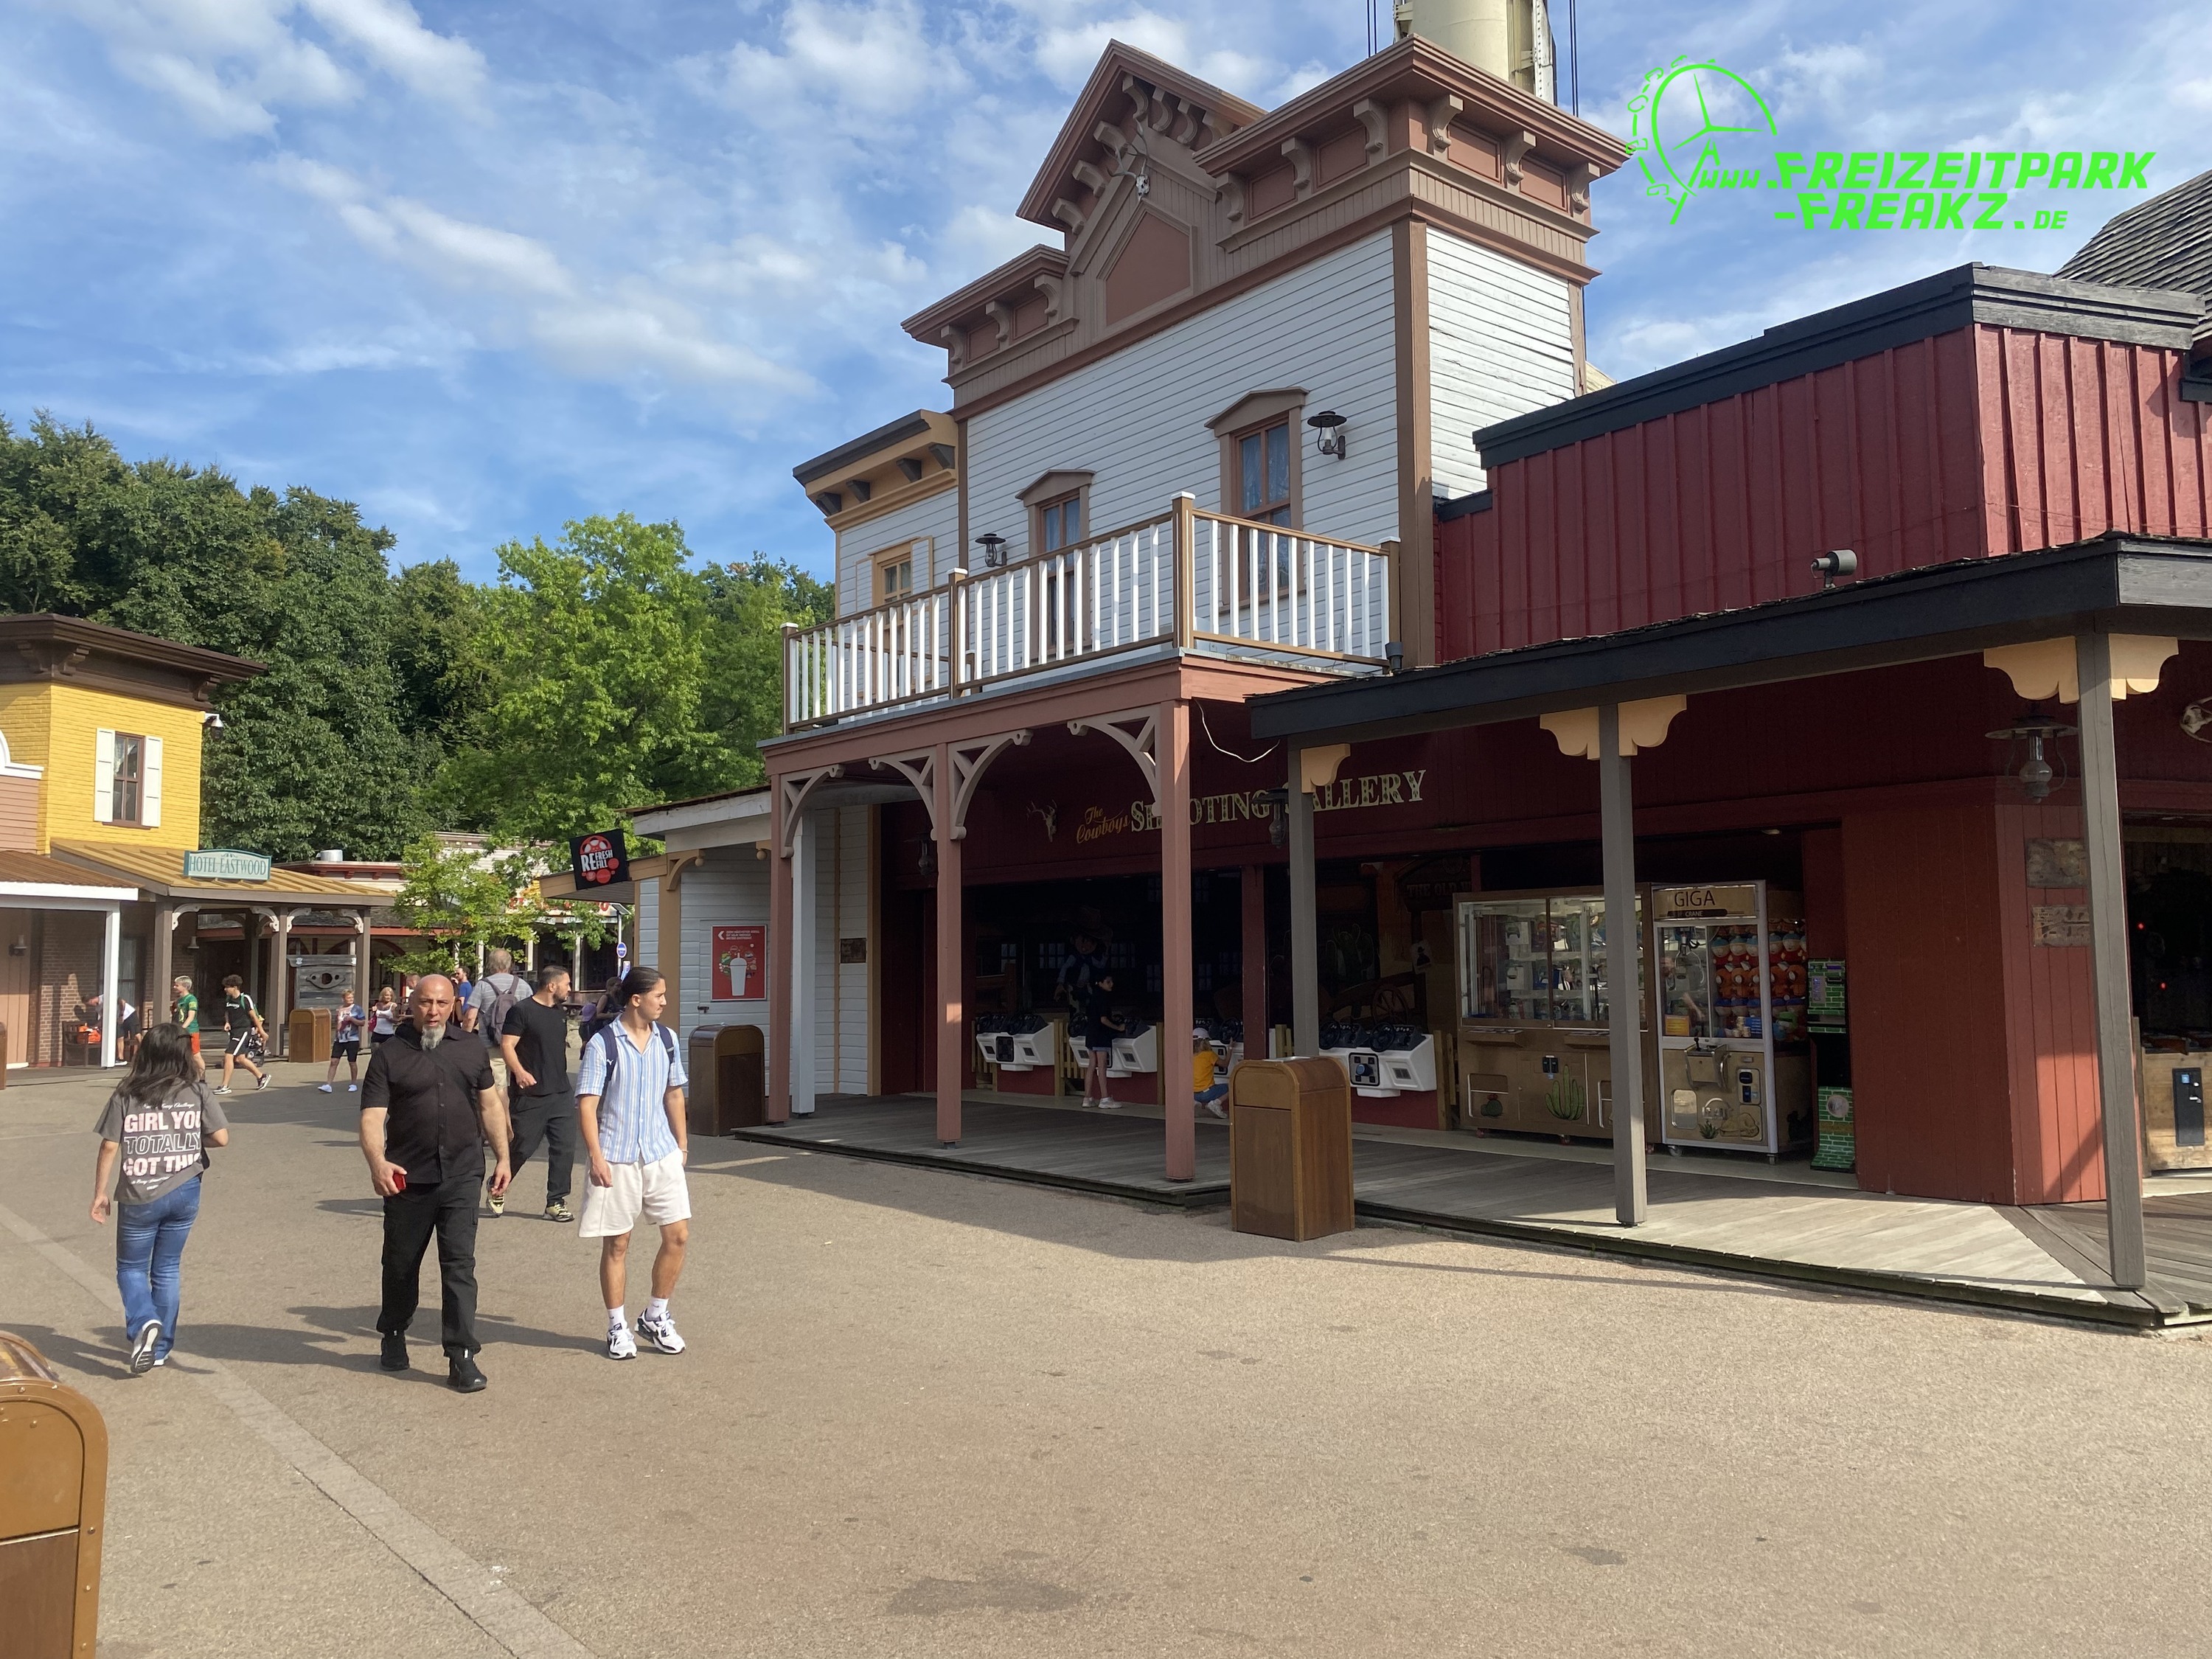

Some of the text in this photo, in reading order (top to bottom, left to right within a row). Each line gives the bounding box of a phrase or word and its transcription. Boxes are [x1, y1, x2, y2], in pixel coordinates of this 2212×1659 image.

[1085, 805, 1104, 825] The
[1130, 790, 1270, 832] SHOTING
[1077, 815, 1129, 844] Cowboys
[189, 856, 266, 875] HOTEL EASTWOOD
[1674, 890, 1716, 907] GIGA
[124, 1112, 169, 1133] GIRL
[123, 1132, 201, 1155] TOTALLY
[122, 1157, 161, 1177] GOT
